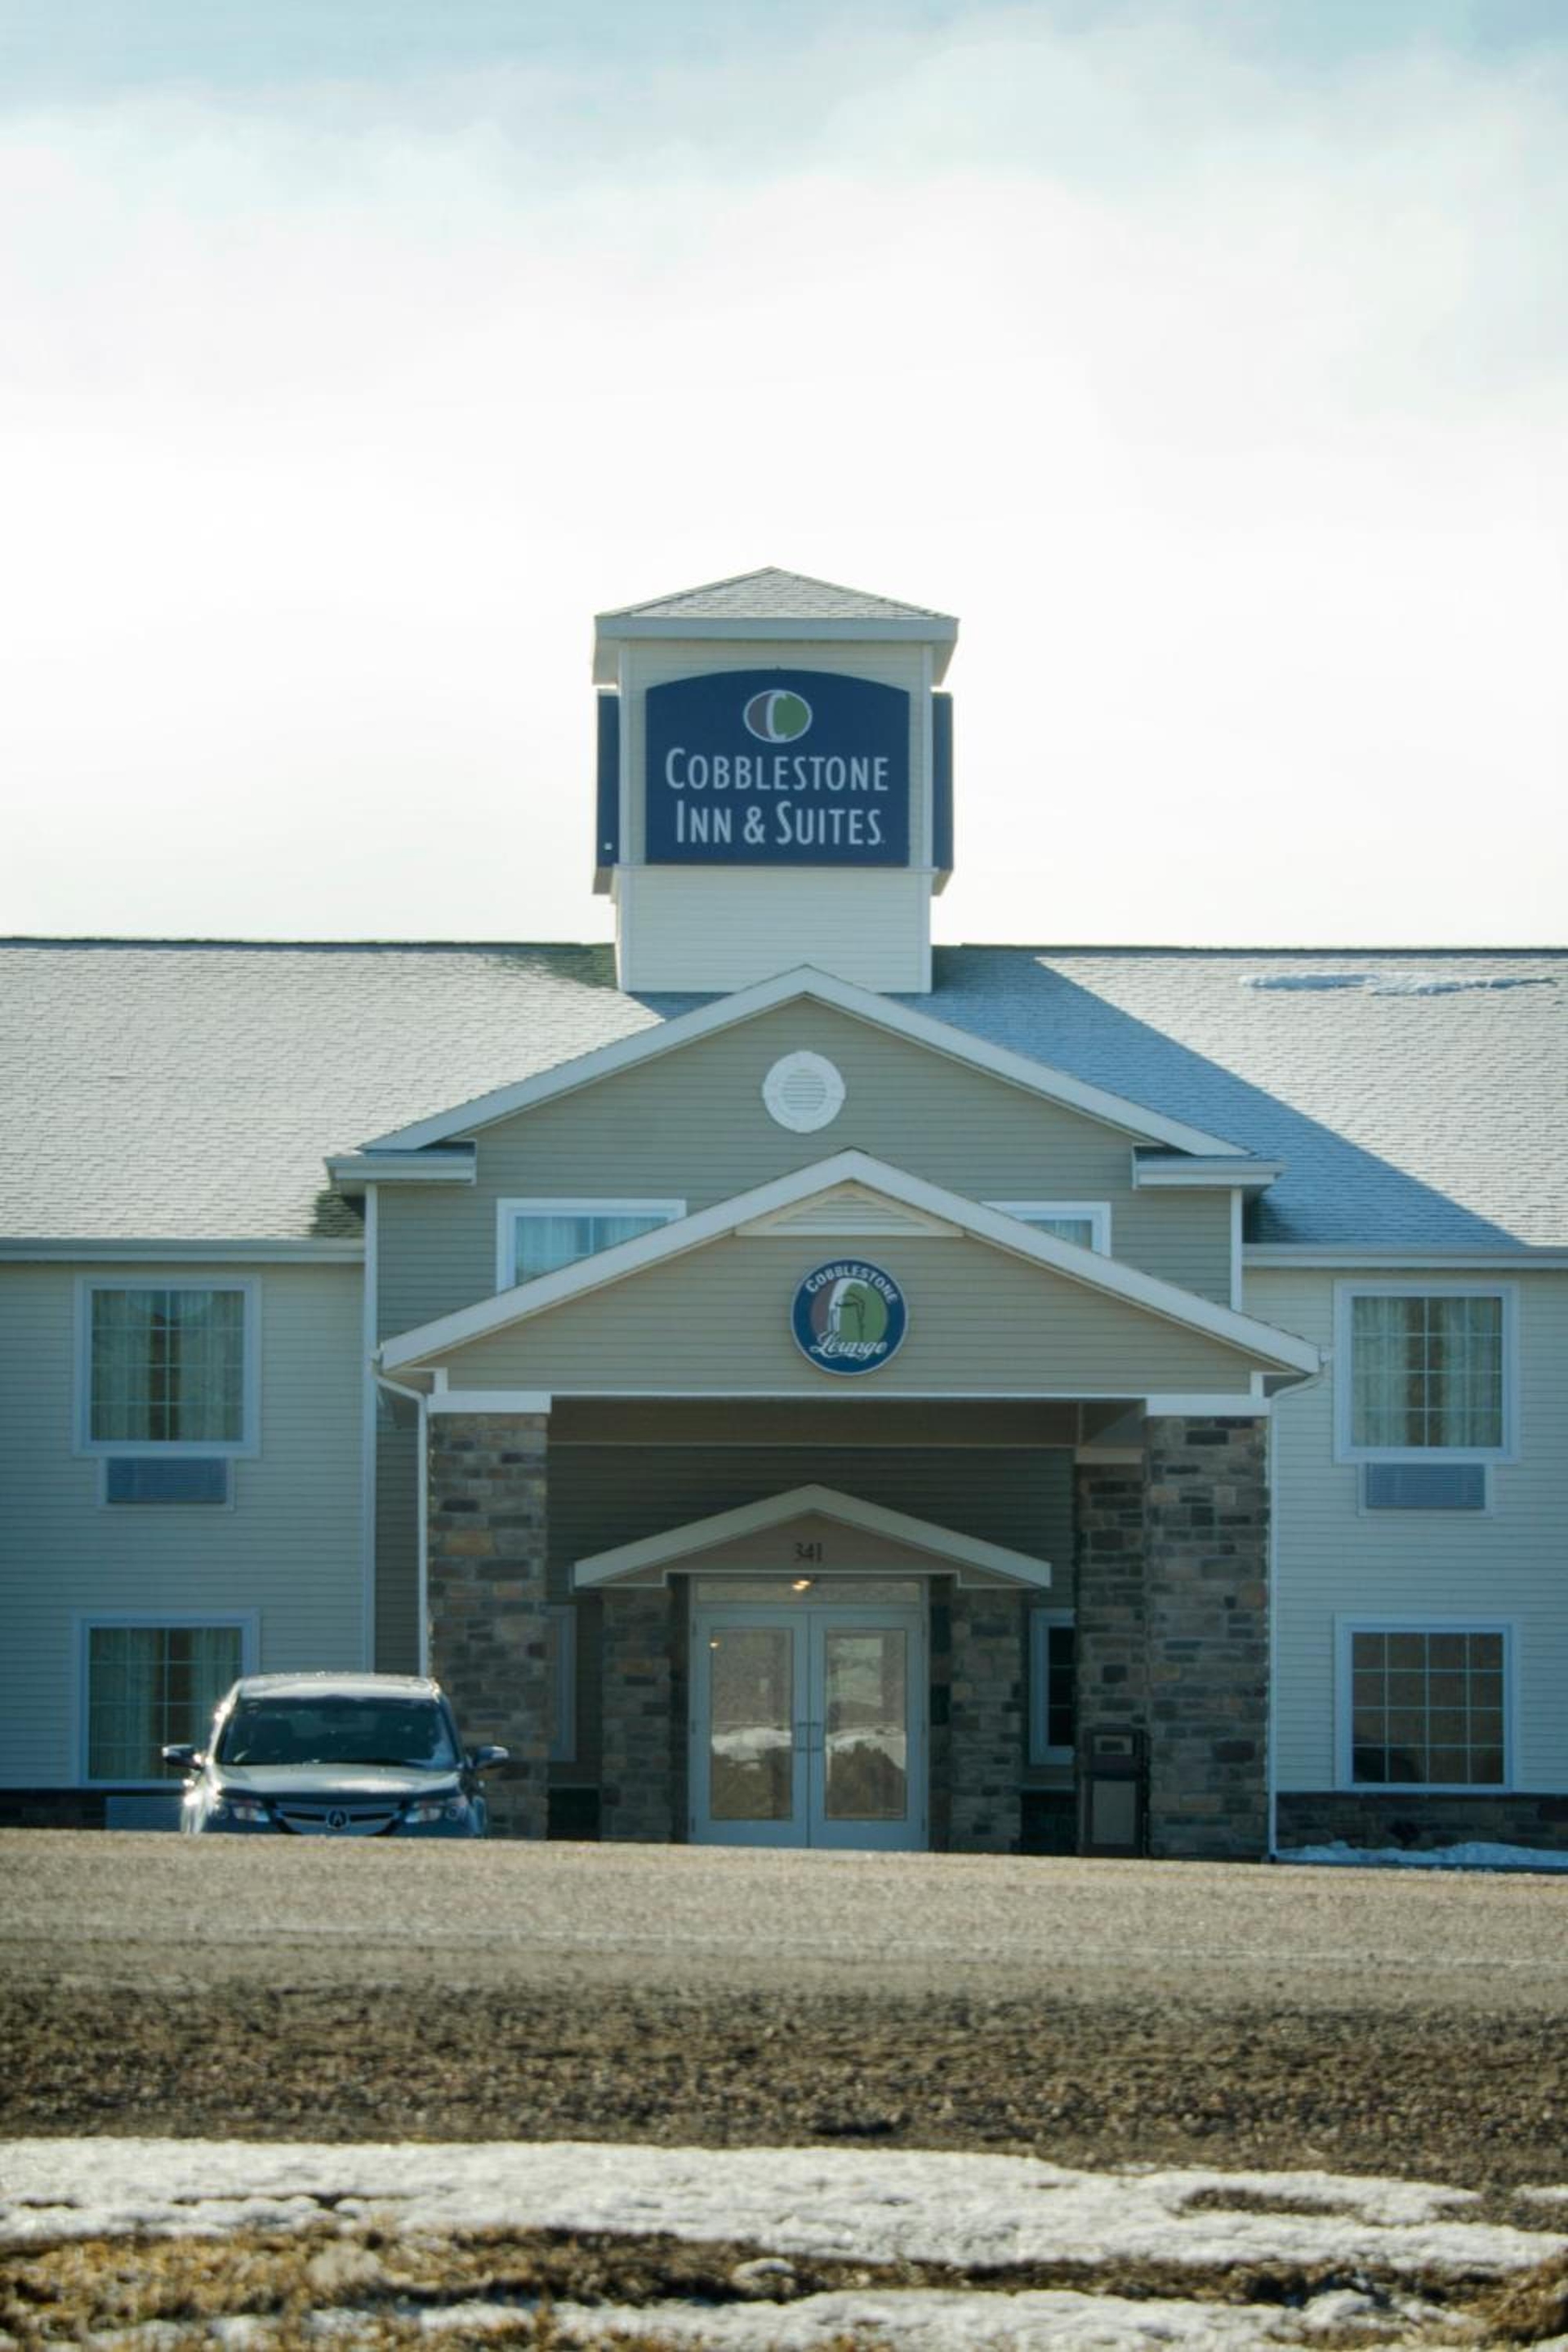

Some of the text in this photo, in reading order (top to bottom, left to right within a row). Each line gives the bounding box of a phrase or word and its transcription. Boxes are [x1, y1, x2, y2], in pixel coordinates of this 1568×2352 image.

[666, 747, 889, 791] COBBLESTONE
[676, 800, 882, 845] INN & SUITES
[805, 1265, 898, 1304] COBBLESTONE
[809, 1330, 888, 1361] Lounge
[794, 1542, 822, 1563] 341
